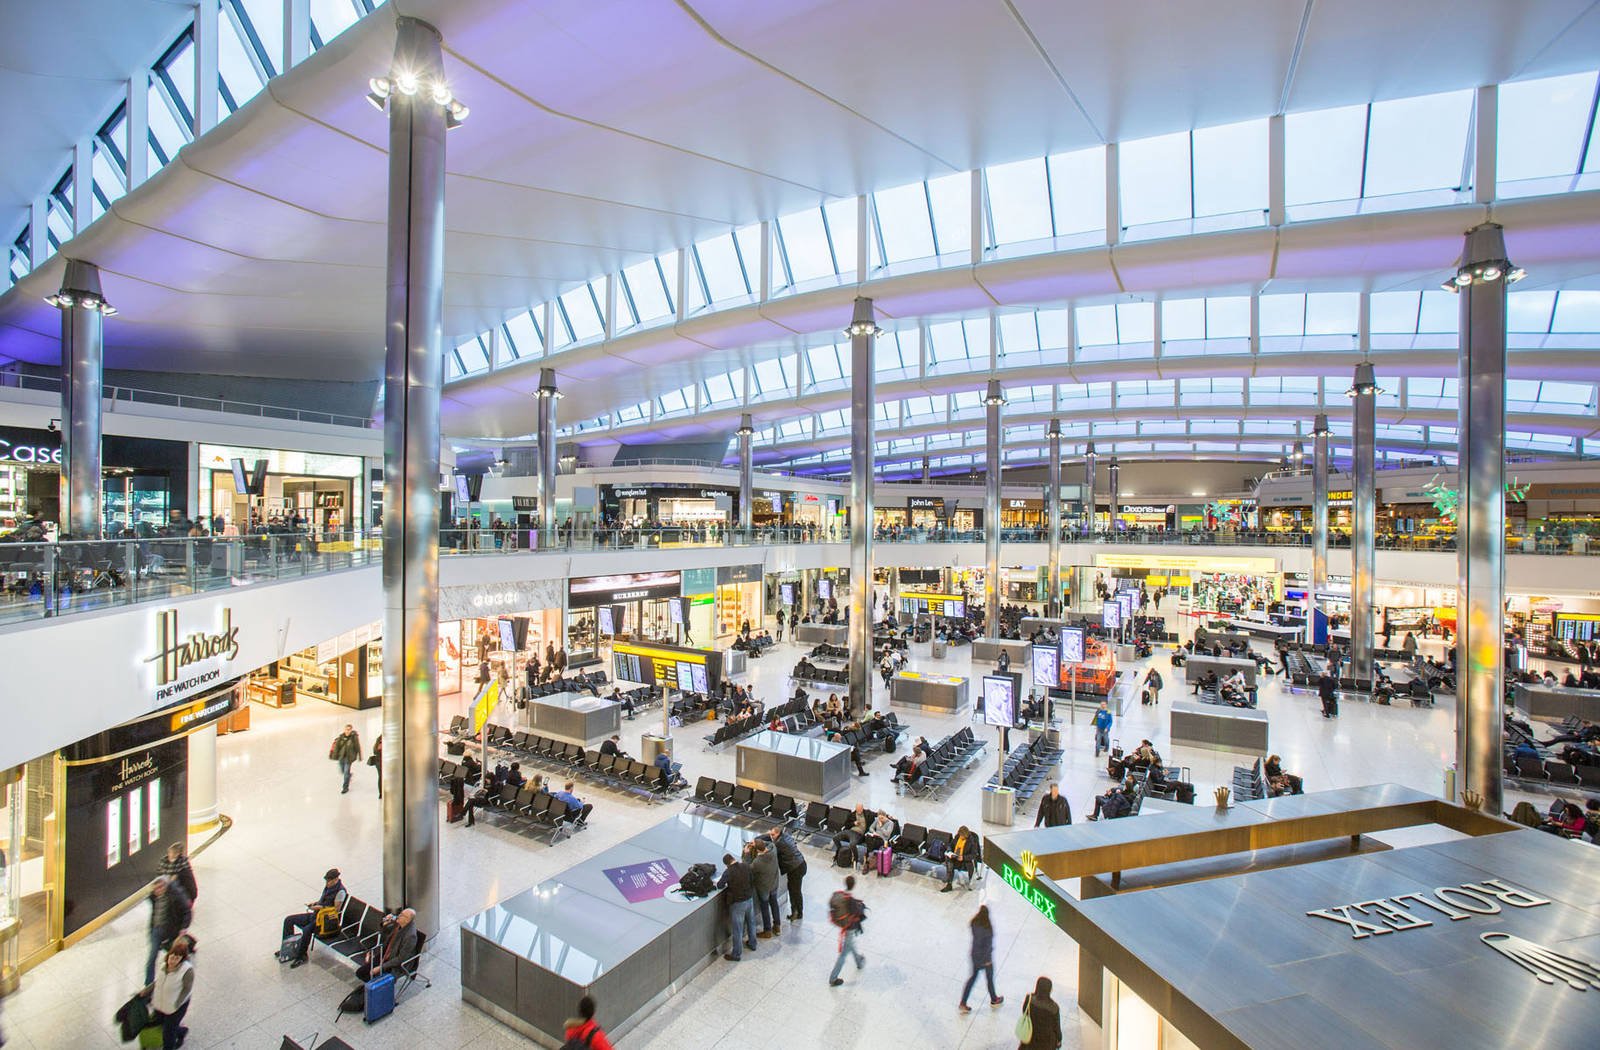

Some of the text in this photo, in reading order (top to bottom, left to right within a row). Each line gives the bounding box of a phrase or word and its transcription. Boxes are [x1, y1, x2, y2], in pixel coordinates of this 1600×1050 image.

[911, 499, 924, 507] John
[1123, 505, 1153, 513] Dixons
[474, 591, 519, 607] GUCCI
[143, 608, 239, 685] Harrods
[157, 669, 220, 700] FINE WATCH ROOM
[112, 766, 159, 792] FINE WATCH ROOM
[118, 752, 153, 781] Harrods
[1002, 864, 1056, 923] ROLEX
[1307, 879, 1551, 939] ROLEX
